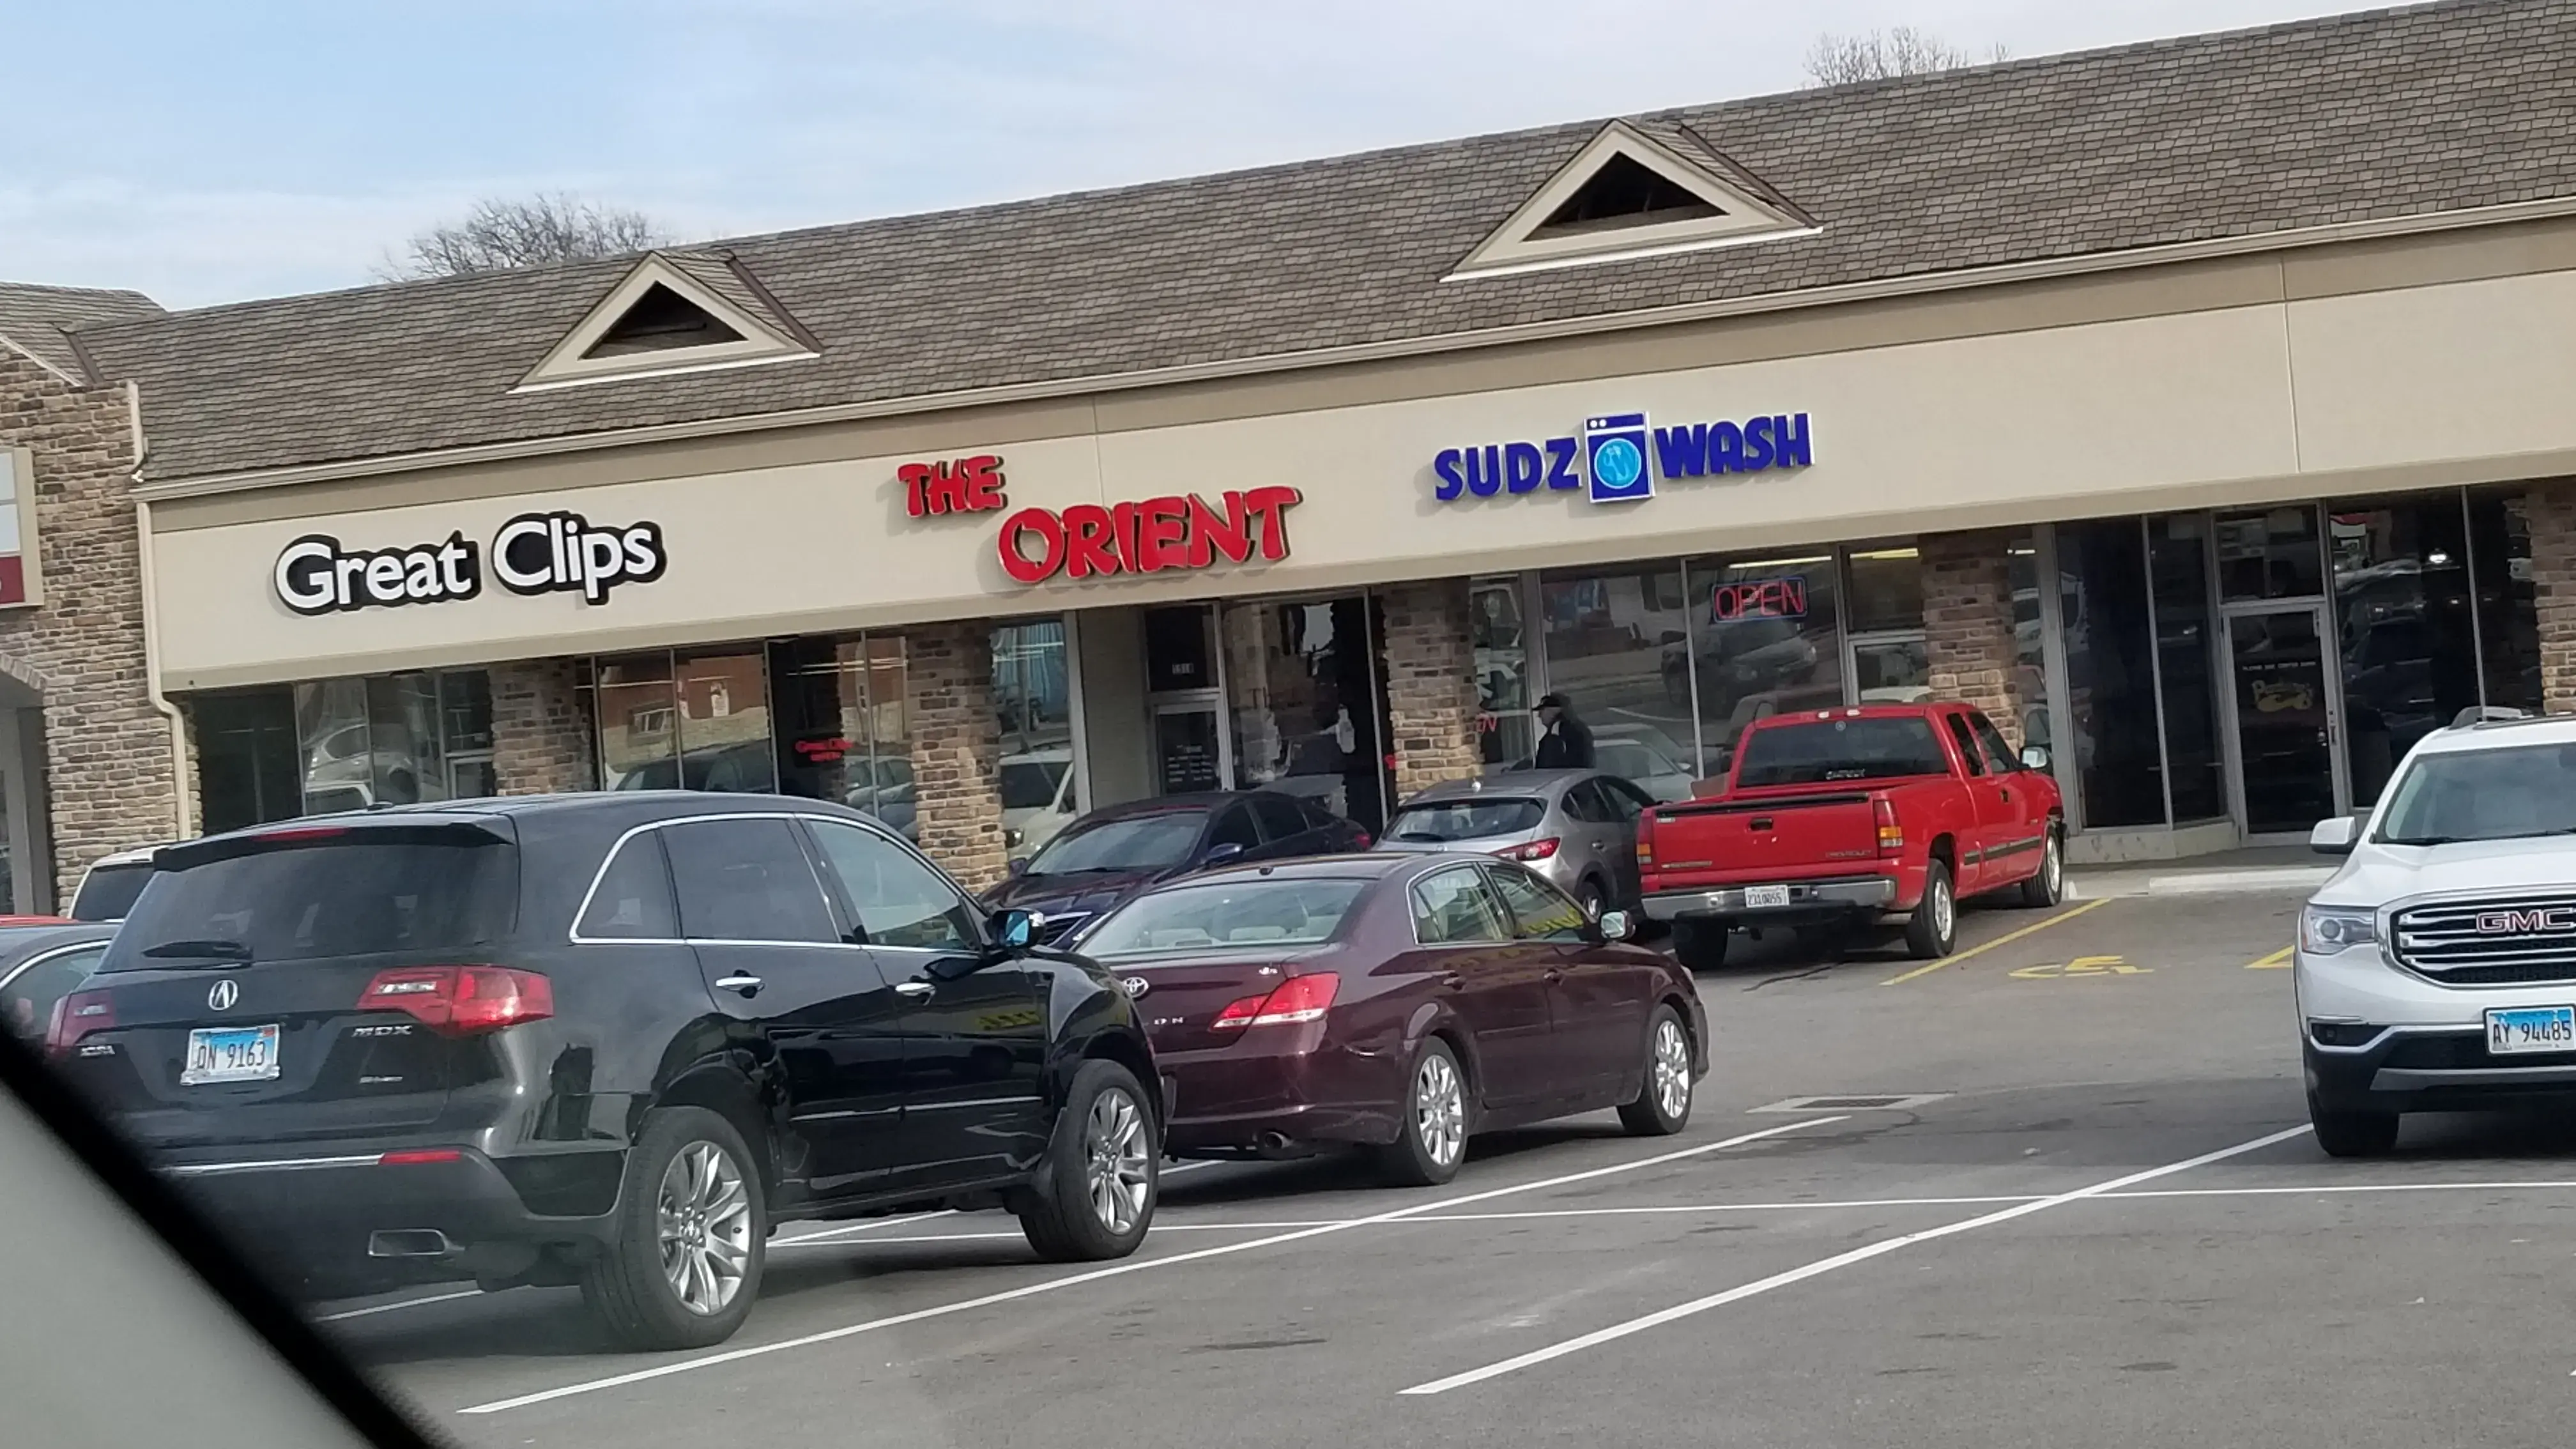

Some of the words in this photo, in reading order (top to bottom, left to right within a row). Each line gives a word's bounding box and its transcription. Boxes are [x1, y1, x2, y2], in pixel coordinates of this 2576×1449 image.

[1434, 436, 1582, 500] SUDZ
[1653, 413, 1814, 479] WASH
[898, 455, 1008, 518] THE
[997, 486, 1303, 584] ORIENT
[275, 539, 474, 611] Great
[492, 515, 661, 601] Clips
[1715, 580, 1804, 619] OPEN
[2476, 907, 2576, 933] GMC
[351, 1025, 413, 1038] MDX
[2493, 1023, 2510, 1045] AY
[2521, 1020, 2572, 1043] 94485
[227, 1040, 266, 1069] 9163
